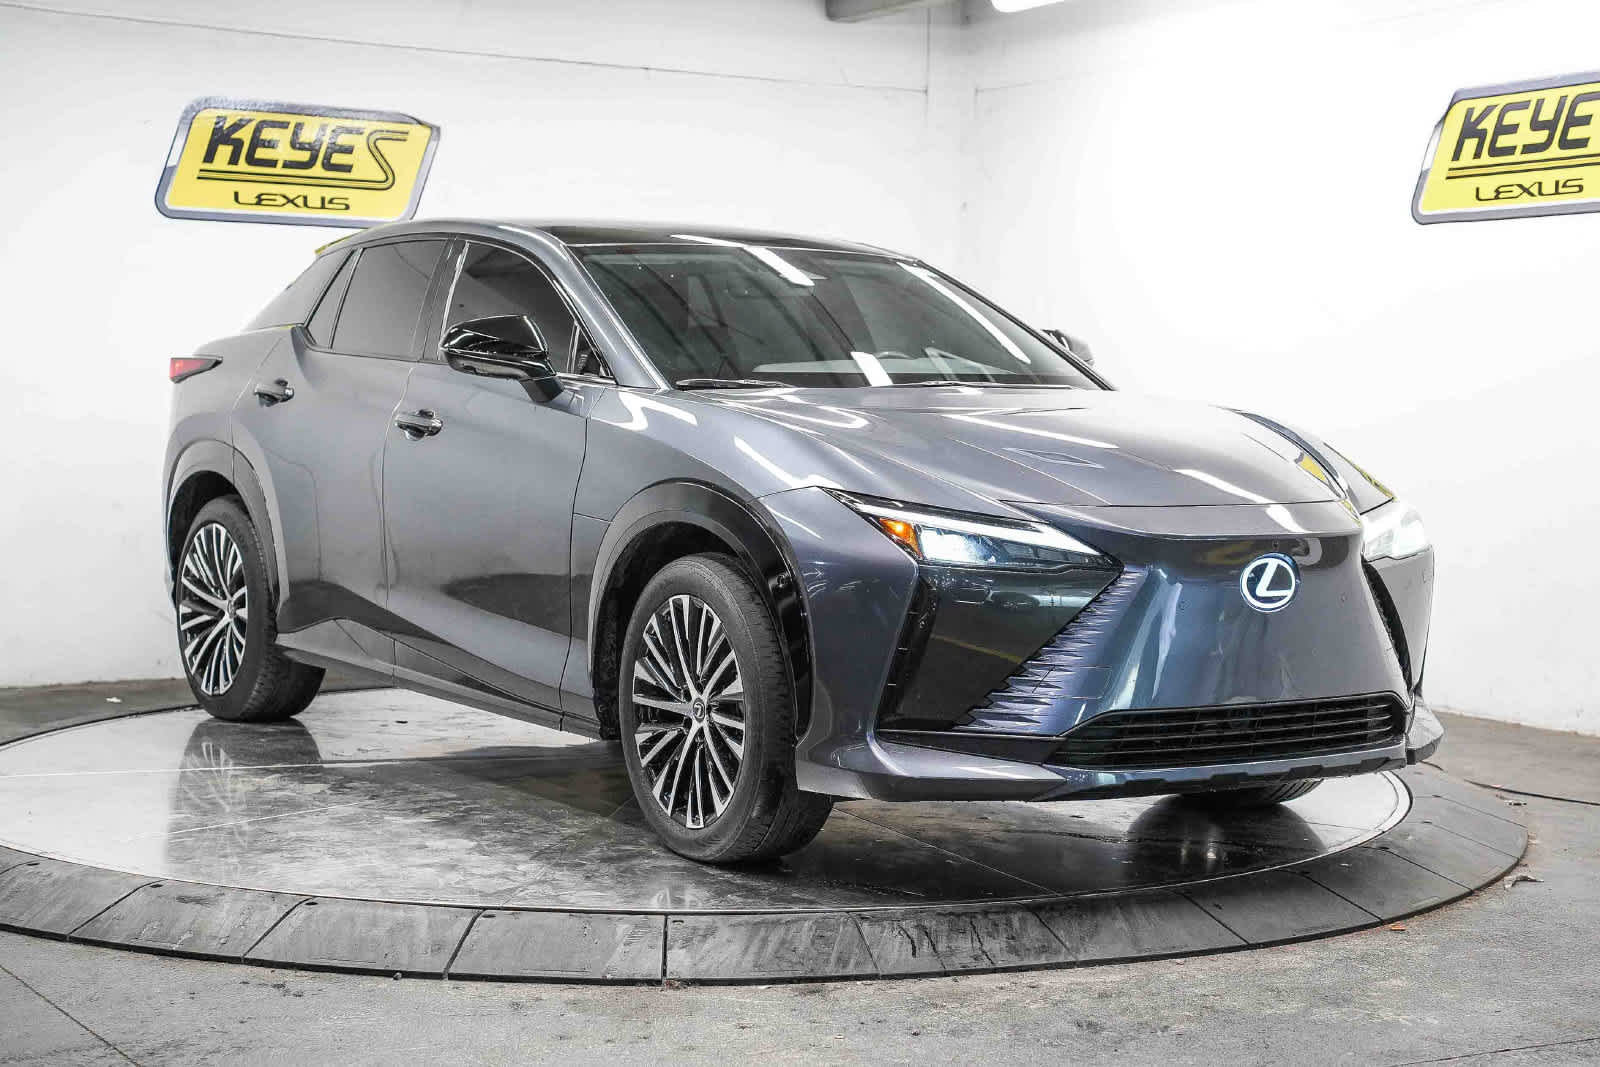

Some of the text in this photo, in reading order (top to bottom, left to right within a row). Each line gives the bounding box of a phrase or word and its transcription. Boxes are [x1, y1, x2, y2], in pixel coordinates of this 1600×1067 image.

[1451, 91, 1600, 161] KEYE
[202, 116, 409, 190] KEYES
[233, 191, 350, 210] LEXUS
[1475, 178, 1584, 201] LEXUS
